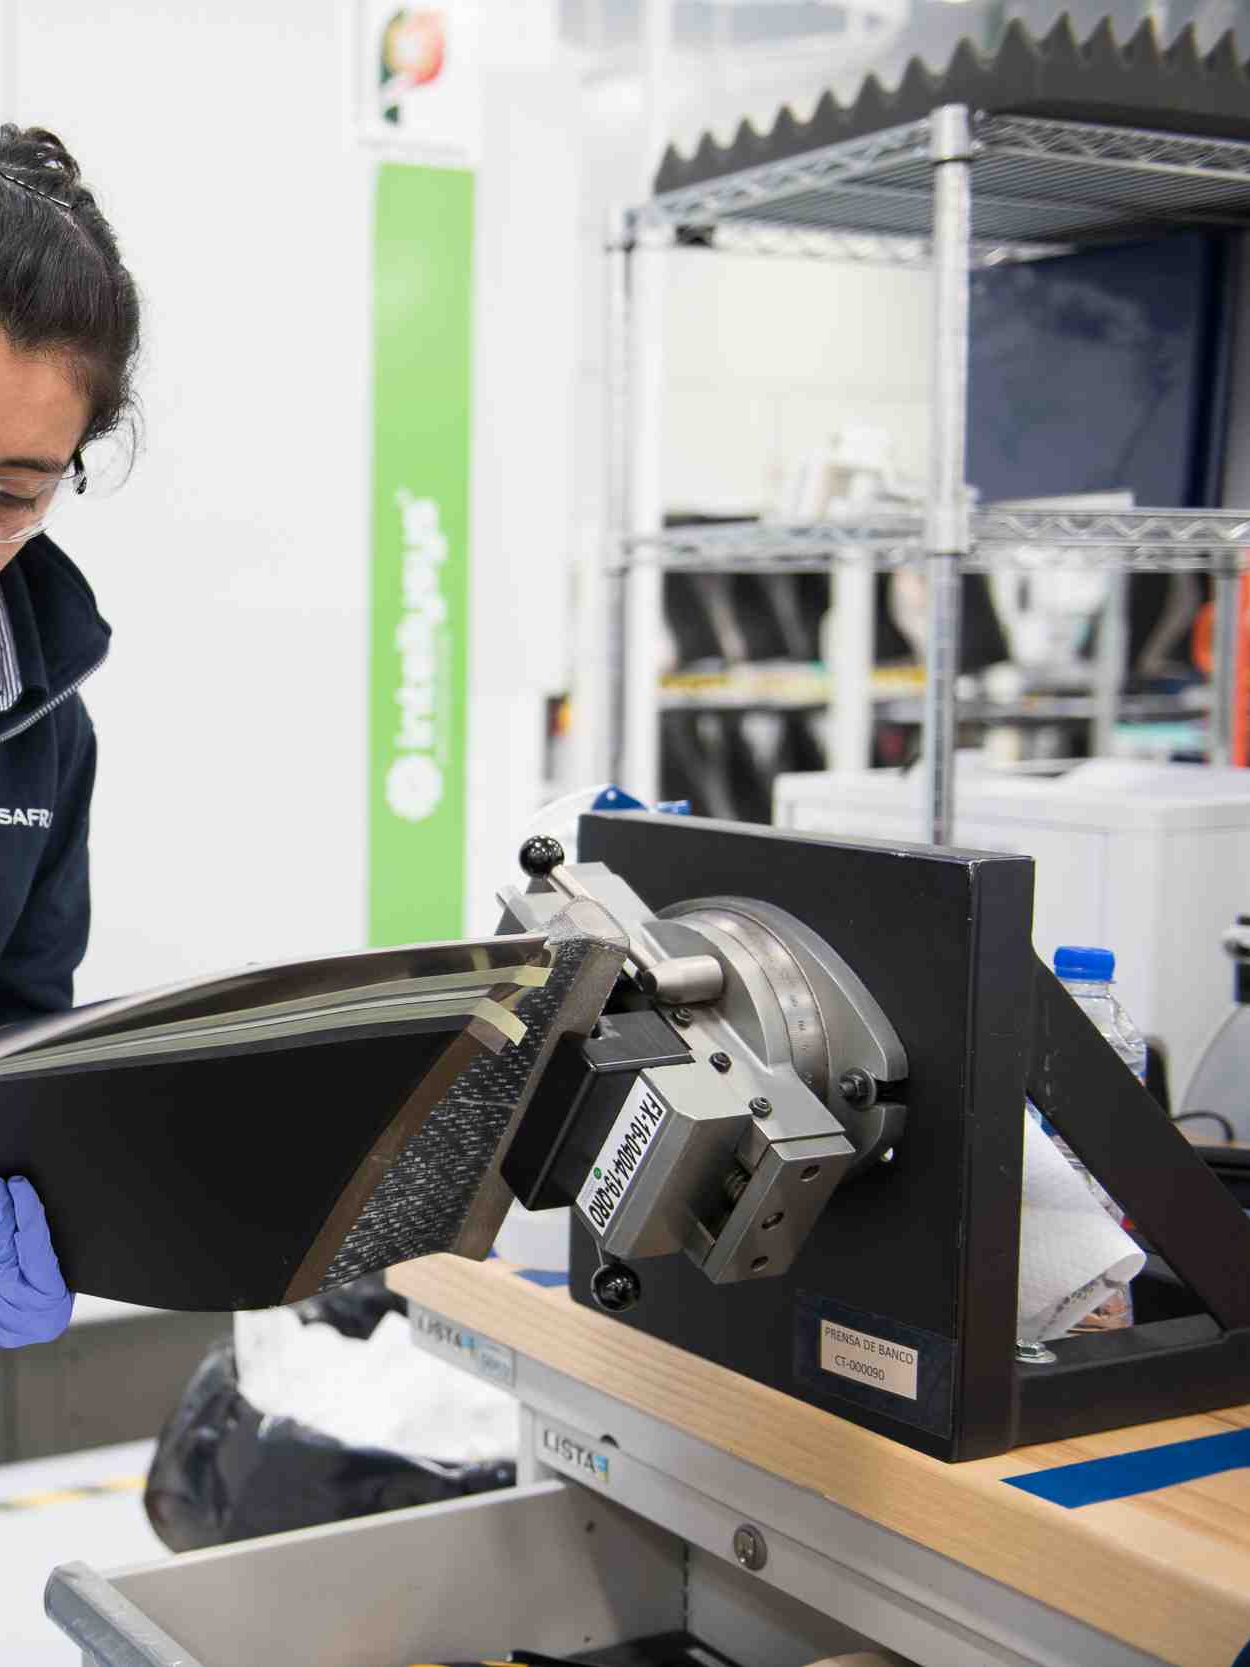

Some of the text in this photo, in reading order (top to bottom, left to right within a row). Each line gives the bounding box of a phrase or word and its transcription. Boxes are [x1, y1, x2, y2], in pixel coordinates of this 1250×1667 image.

[588, 1092, 665, 1228] FX-16-0404-19-QRO
[417, 1315, 462, 1349] LISTA
[824, 1326, 914, 1365] PRENSA DE BANCO
[834, 1354, 885, 1381] CT-000090
[544, 1430, 596, 1474] LISTA
